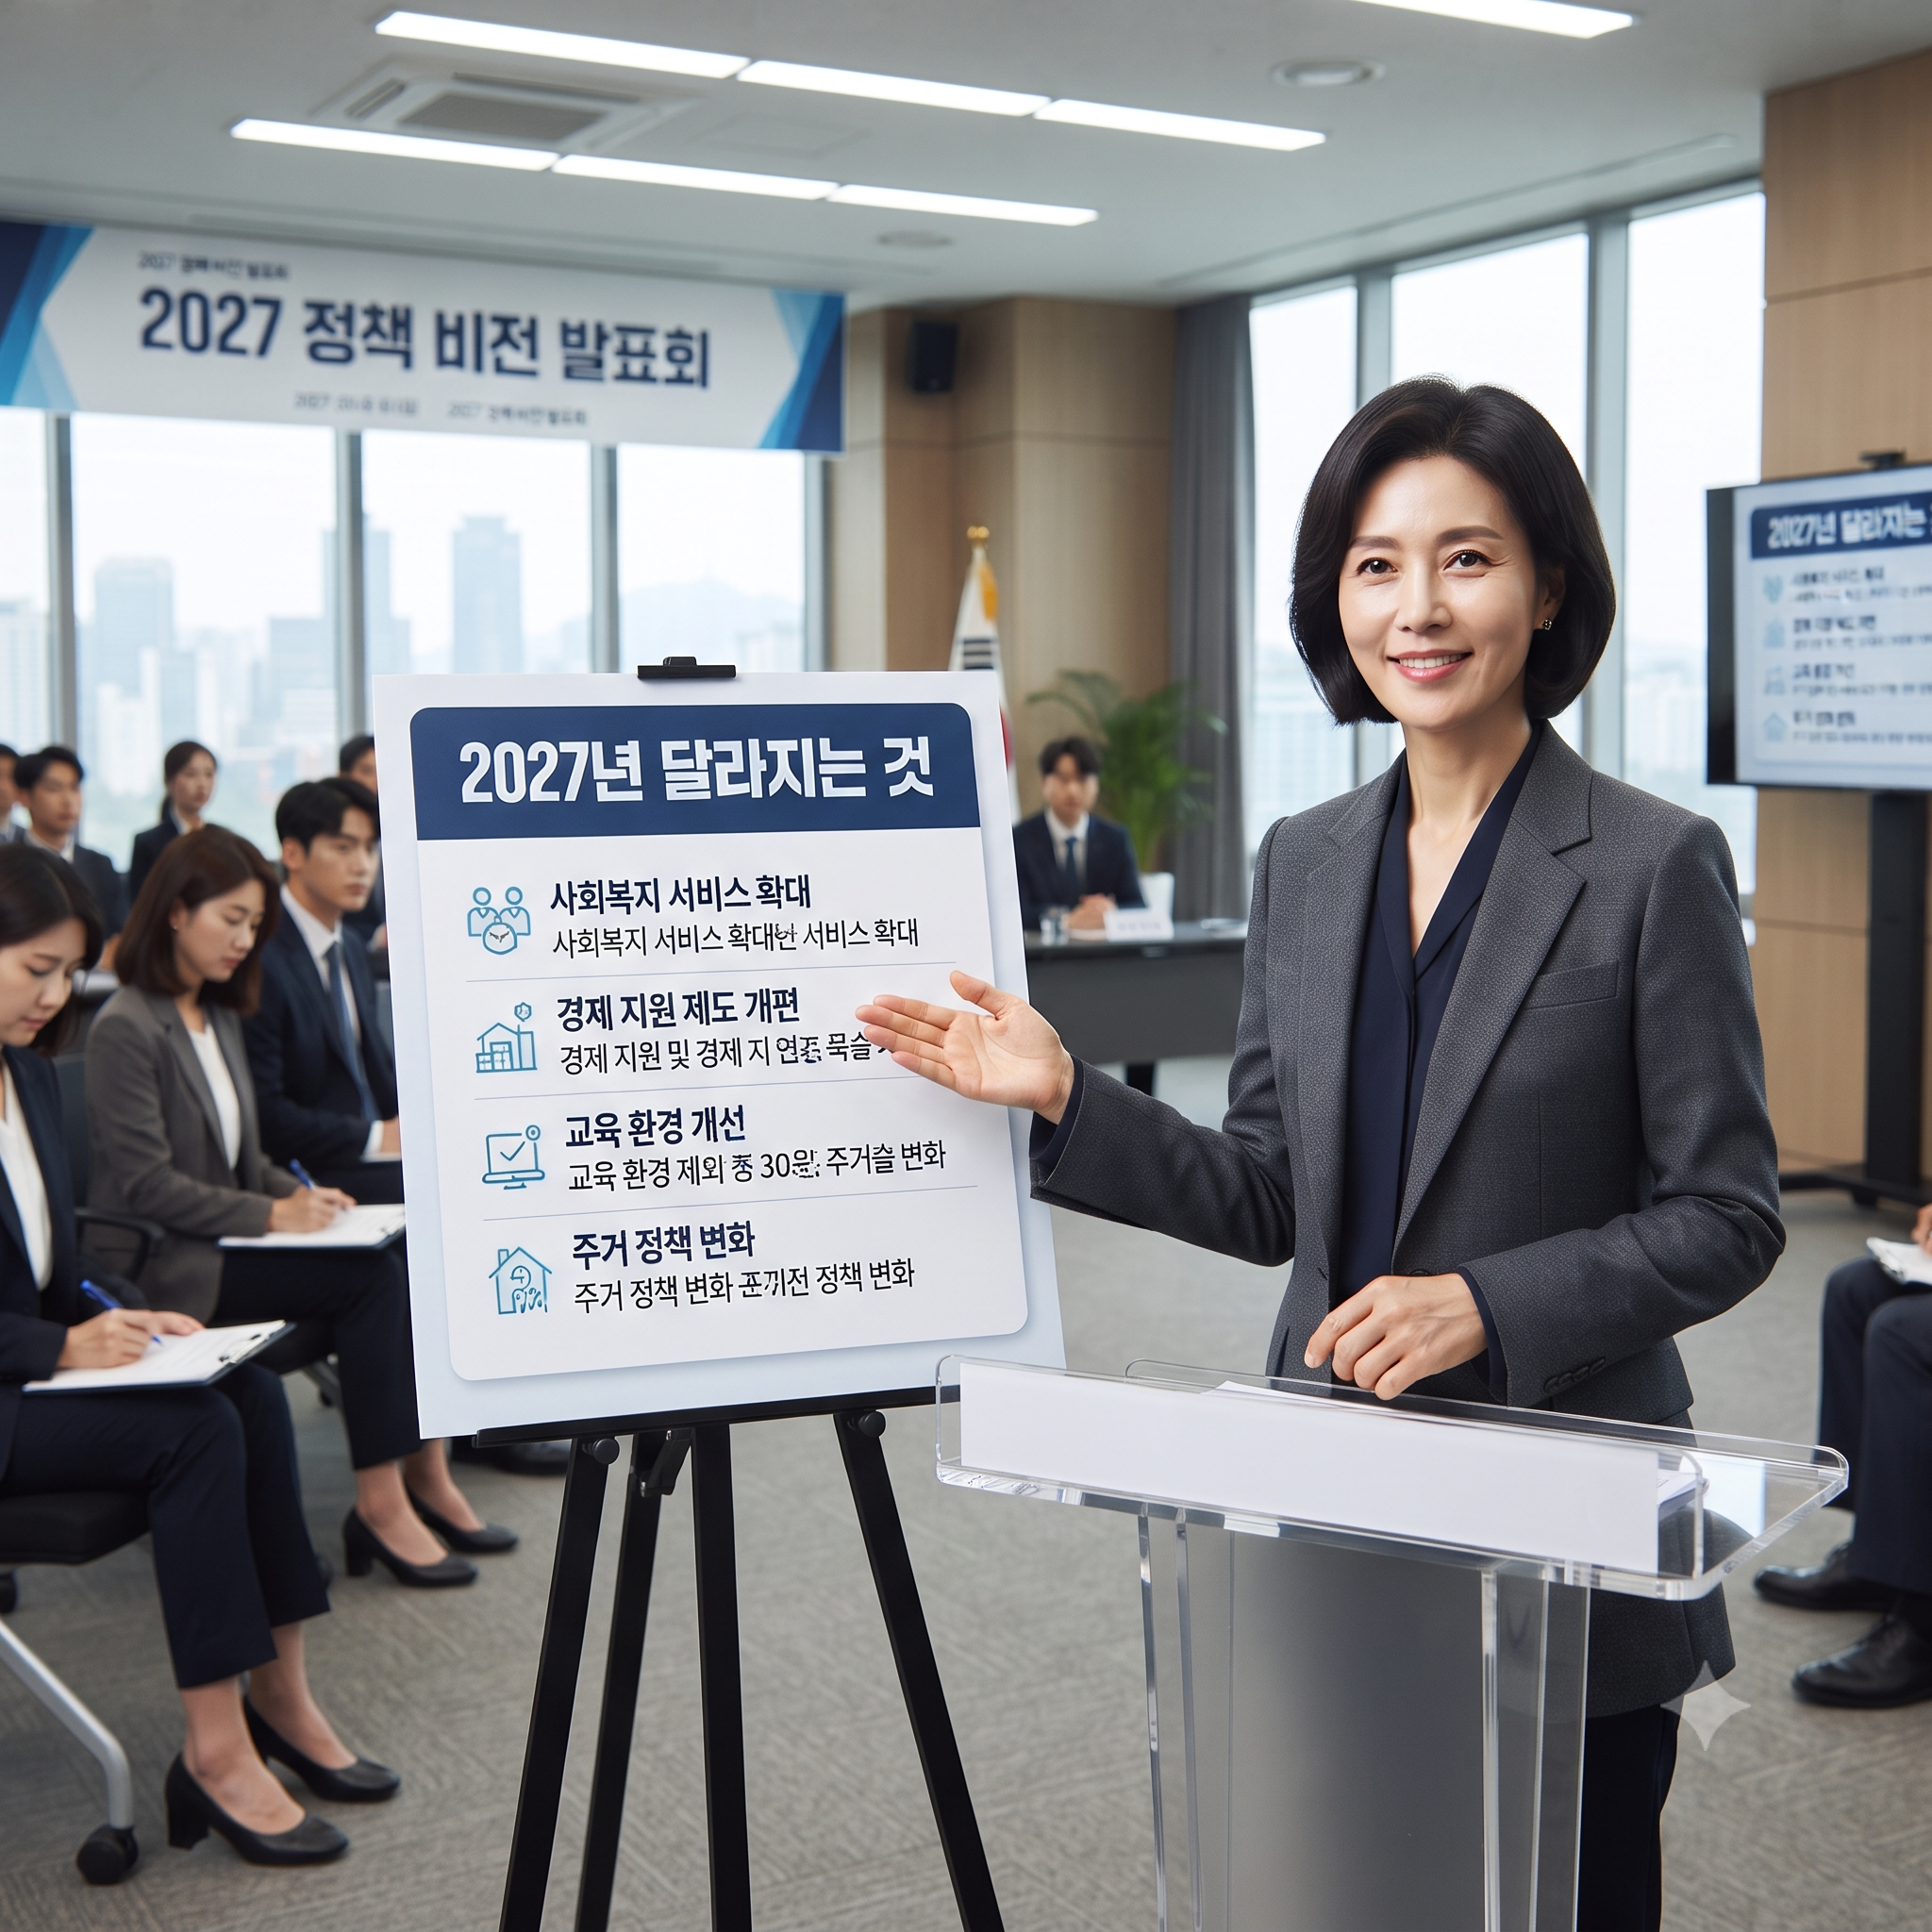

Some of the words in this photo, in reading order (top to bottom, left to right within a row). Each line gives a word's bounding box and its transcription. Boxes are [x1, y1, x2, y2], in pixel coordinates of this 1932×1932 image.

[140, 285, 283, 358] 2027
[304, 300, 413, 370] 정책
[435, 310, 538, 376] 비전
[559, 320, 708, 388] 발표회
[1840, 502, 1926, 544] 달라지는
[460, 741, 642, 803] 2027년
[661, 738, 866, 800] 달라지는
[884, 737, 933, 796] 것
[551, 878, 659, 915] 사회복지
[669, 876, 751, 912] 서비스
[756, 874, 810, 909] 확대
[553, 926, 646, 958] 사회복지
[655, 924, 724, 955] 서비스
[804, 921, 870, 950] 서비스
[874, 918, 918, 946] 확대
[558, 995, 613, 1032] 경제
[621, 992, 676, 1028] 지원
[682, 991, 738, 1025] 제도
[744, 988, 799, 1024] 개편
[561, 1043, 607, 1074] 경제
[615, 1041, 661, 1072] 지원
[668, 1040, 689, 1070] 및
[697, 1038, 741, 1068] 경제
[566, 1113, 622, 1148] 교육
[628, 1108, 682, 1146] 환경
[691, 1105, 745, 1142] 개선
[569, 1161, 616, 1191] 교육
[623, 1158, 669, 1190] 환경
[902, 1140, 946, 1171] 변화
[573, 1230, 627, 1270] 주거
[635, 1225, 691, 1264] 정책
[700, 1221, 755, 1259] 변화
[575, 1280, 622, 1313] 주거
[630, 1275, 677, 1308] 정책
[686, 1273, 733, 1305] 변화
[816, 1262, 862, 1294] 정책
[870, 1258, 914, 1290] 변화
